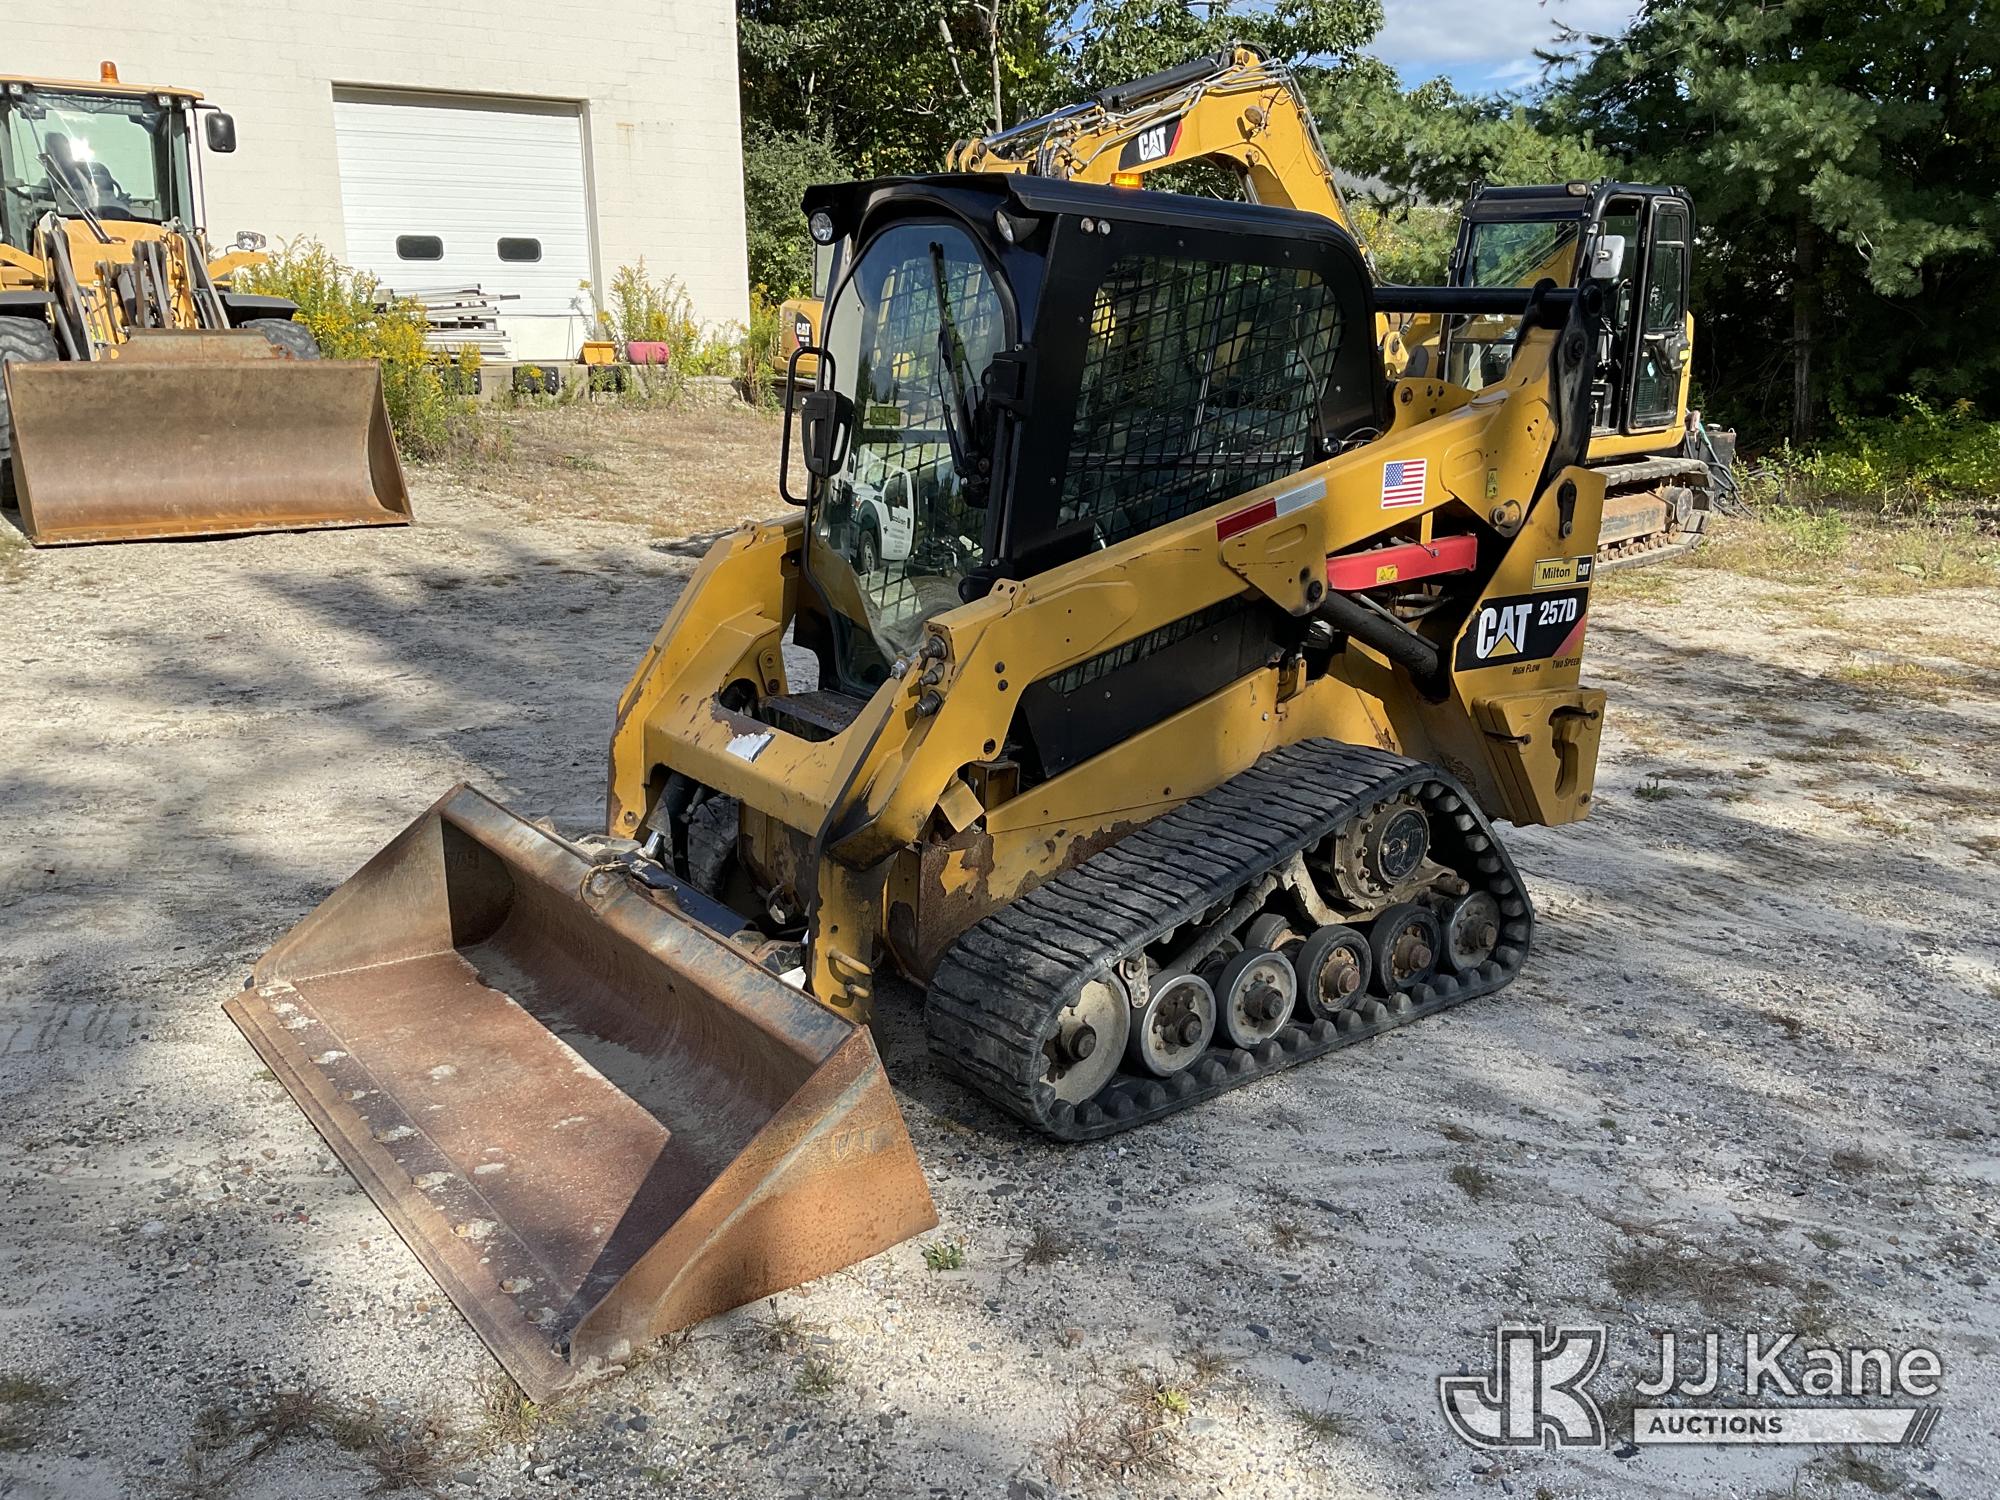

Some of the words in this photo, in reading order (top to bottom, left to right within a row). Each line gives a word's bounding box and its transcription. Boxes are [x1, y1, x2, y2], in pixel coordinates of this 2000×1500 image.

[1138, 126, 1166, 161] CAT
[796, 322, 810, 336] CAT
[1542, 566, 1570, 580] Milton
[1577, 563, 1590, 576] CAT
[1476, 603, 1533, 659] CAT
[1538, 597, 1577, 626] 257D
